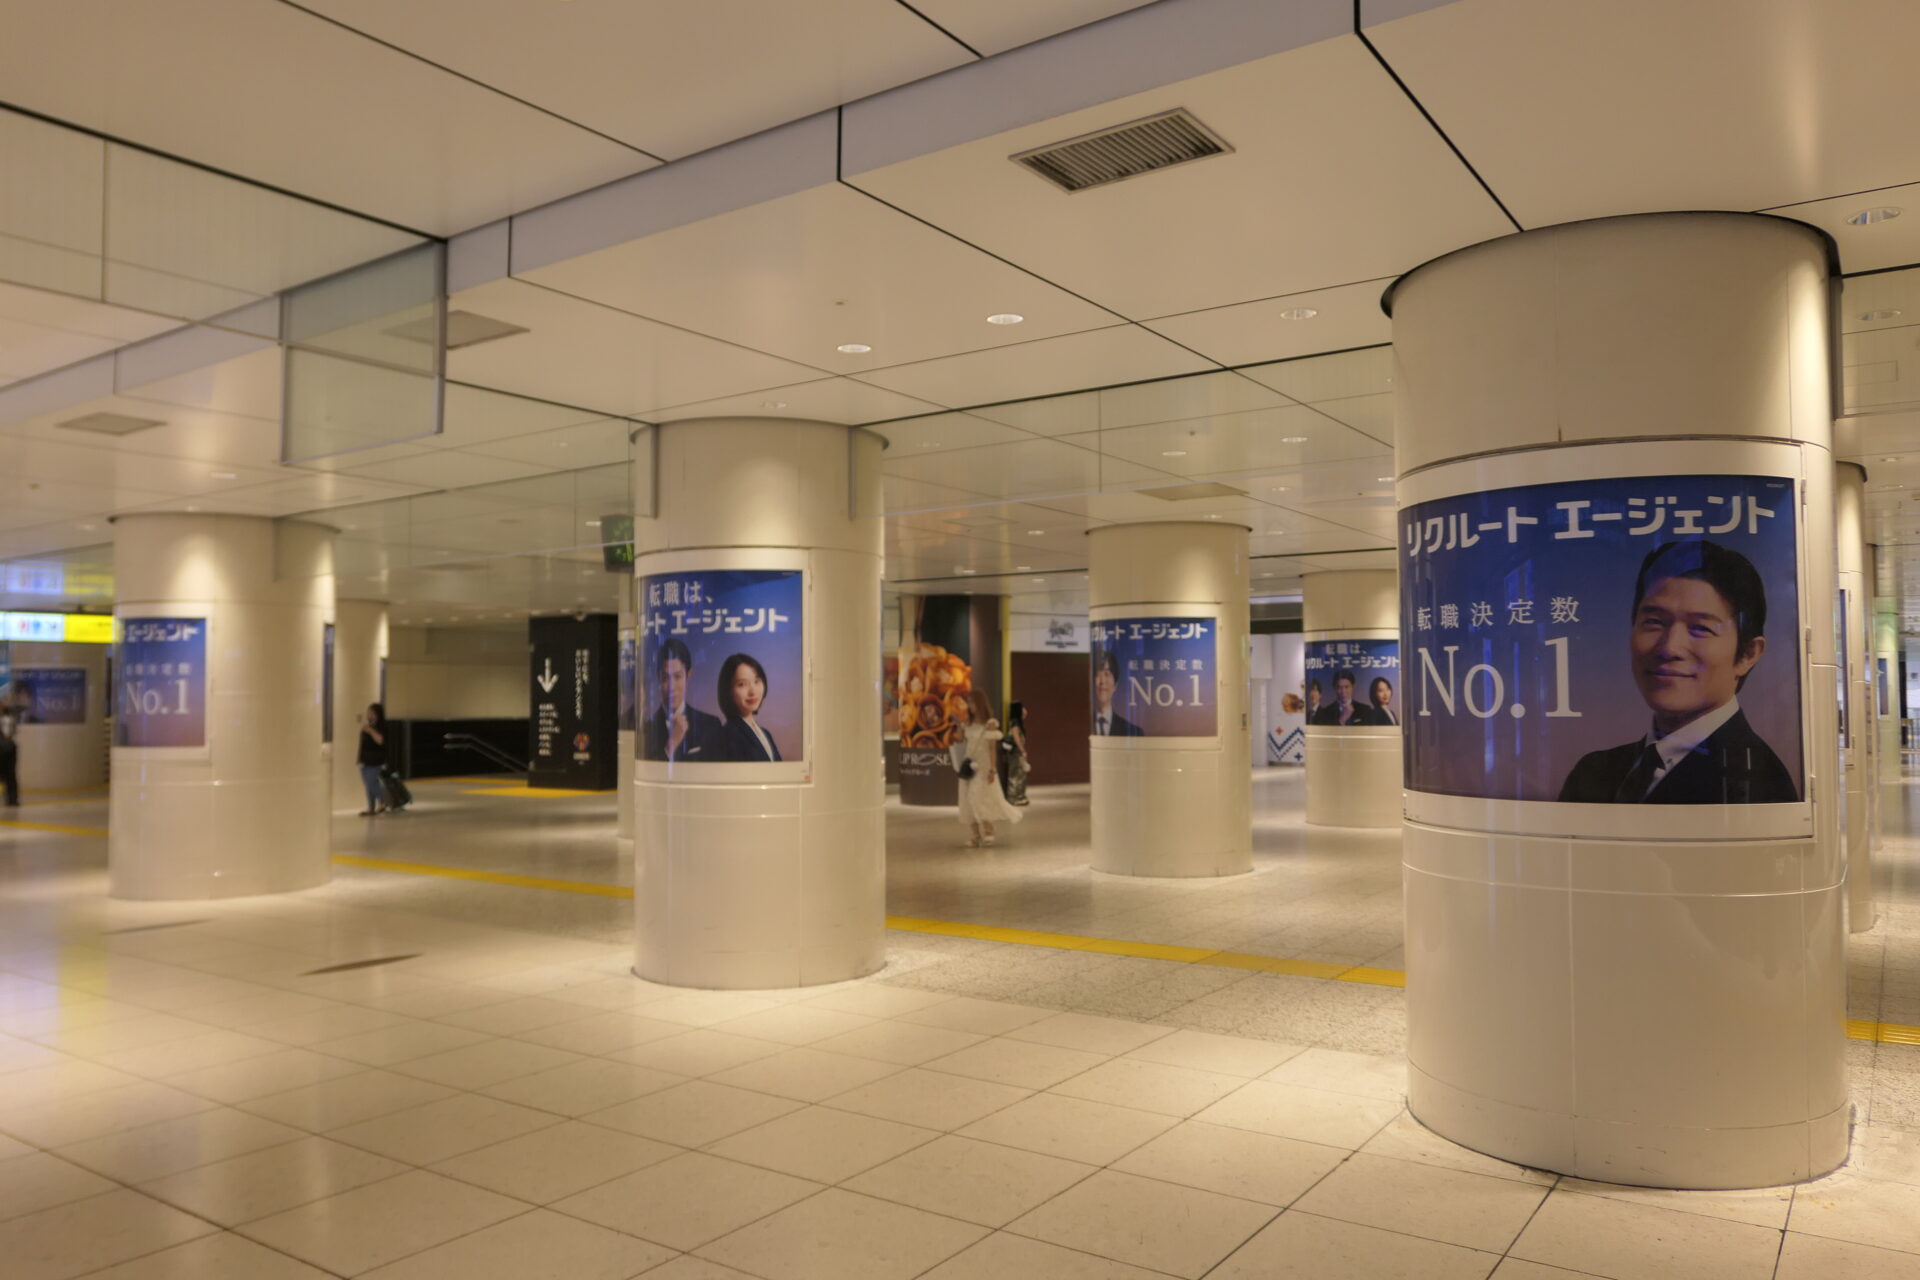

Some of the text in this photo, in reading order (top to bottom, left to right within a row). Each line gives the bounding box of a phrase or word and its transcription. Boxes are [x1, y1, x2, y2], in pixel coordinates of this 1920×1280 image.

[1406, 495, 1775, 557] リクルート エージェント
[650, 581, 714, 606] 転職は、
[671, 608, 788, 634] エージェント
[1417, 596, 1580, 631] 転職決定数
[1129, 623, 1208, 639] エージェント
[1342, 656, 1399, 668] エージェント
[1417, 636, 1583, 719] No.1
[126, 679, 190, 715] No.1
[1128, 674, 1204, 707] No.1
